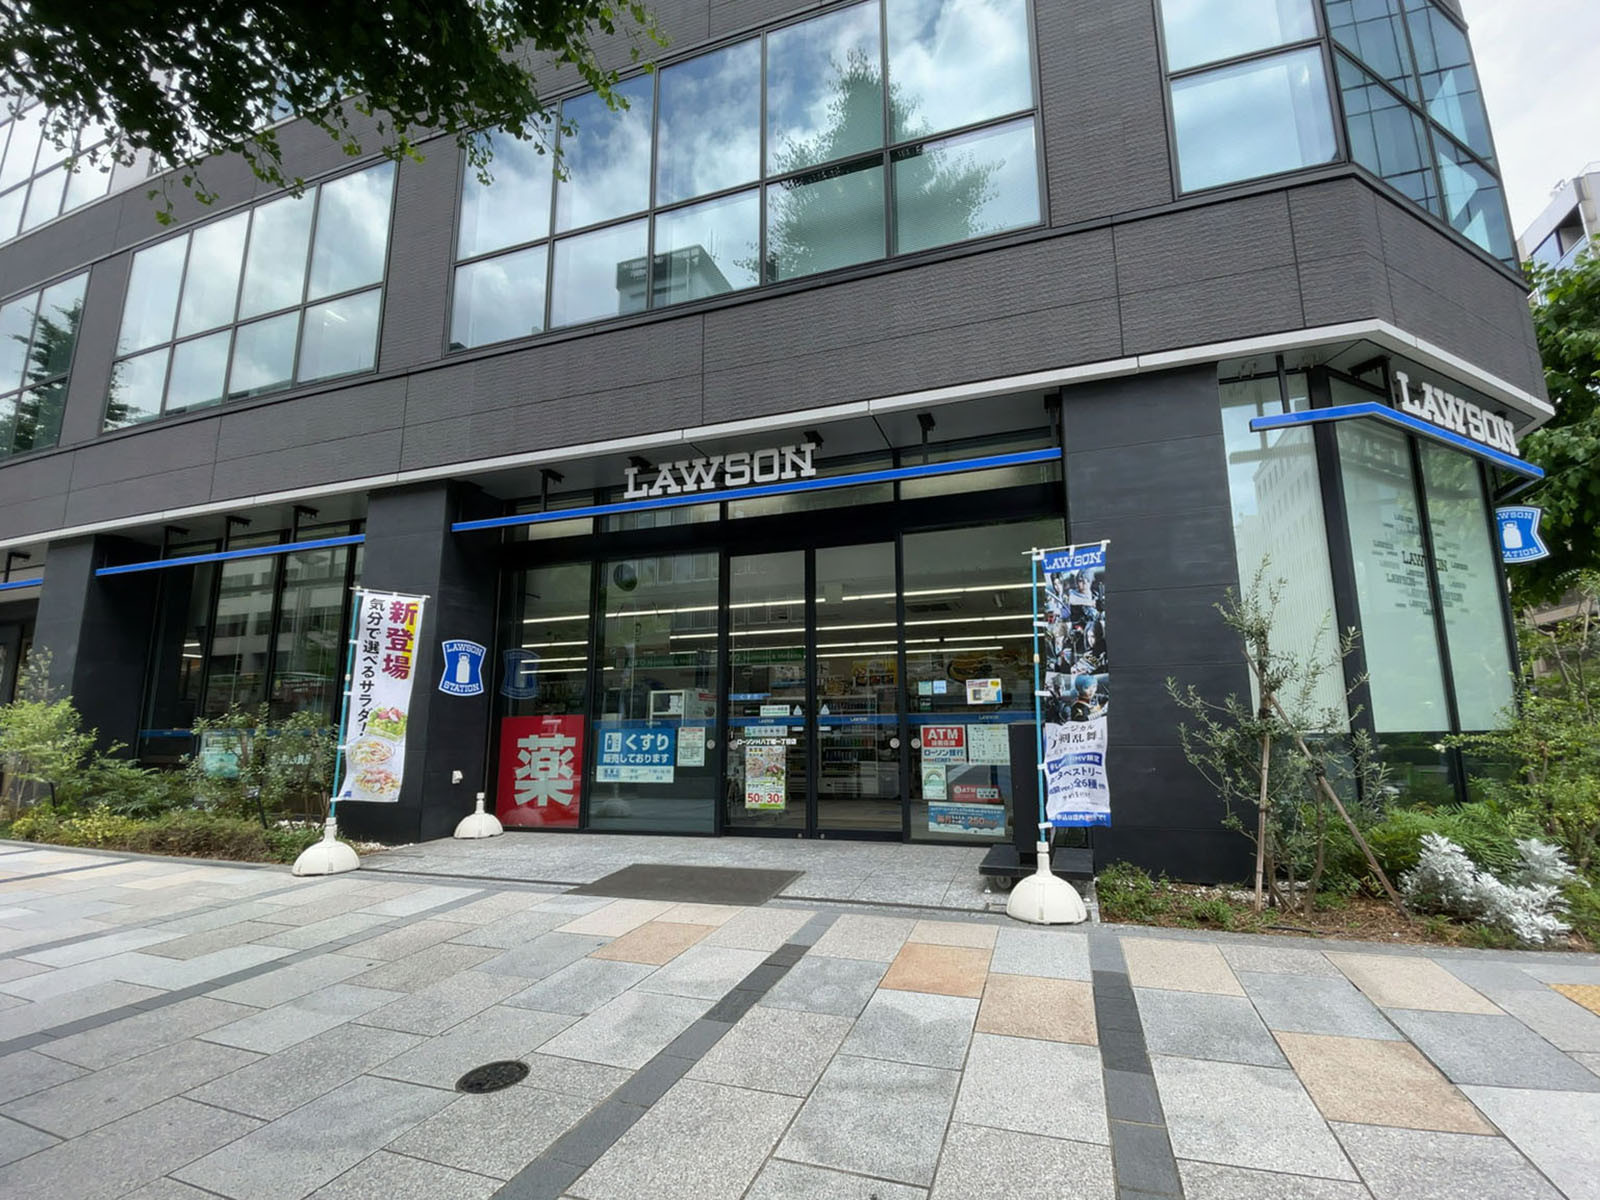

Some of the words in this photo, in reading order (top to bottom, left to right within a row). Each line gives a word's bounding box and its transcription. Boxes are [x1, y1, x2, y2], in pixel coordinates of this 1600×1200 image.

[1396, 371, 1520, 456] LAWSON
[624, 443, 816, 499] LAWSON
[1043, 551, 1102, 570] LAWSON
[382, 600, 418, 680] 新登場
[446, 643, 483, 656] LAWSON
[357, 598, 386, 737] 気分で選べるサラダ！
[443, 681, 480, 692] STATION
[626, 733, 670, 751] くすり
[928, 729, 958, 739] ATM
[514, 733, 576, 807] 薬
